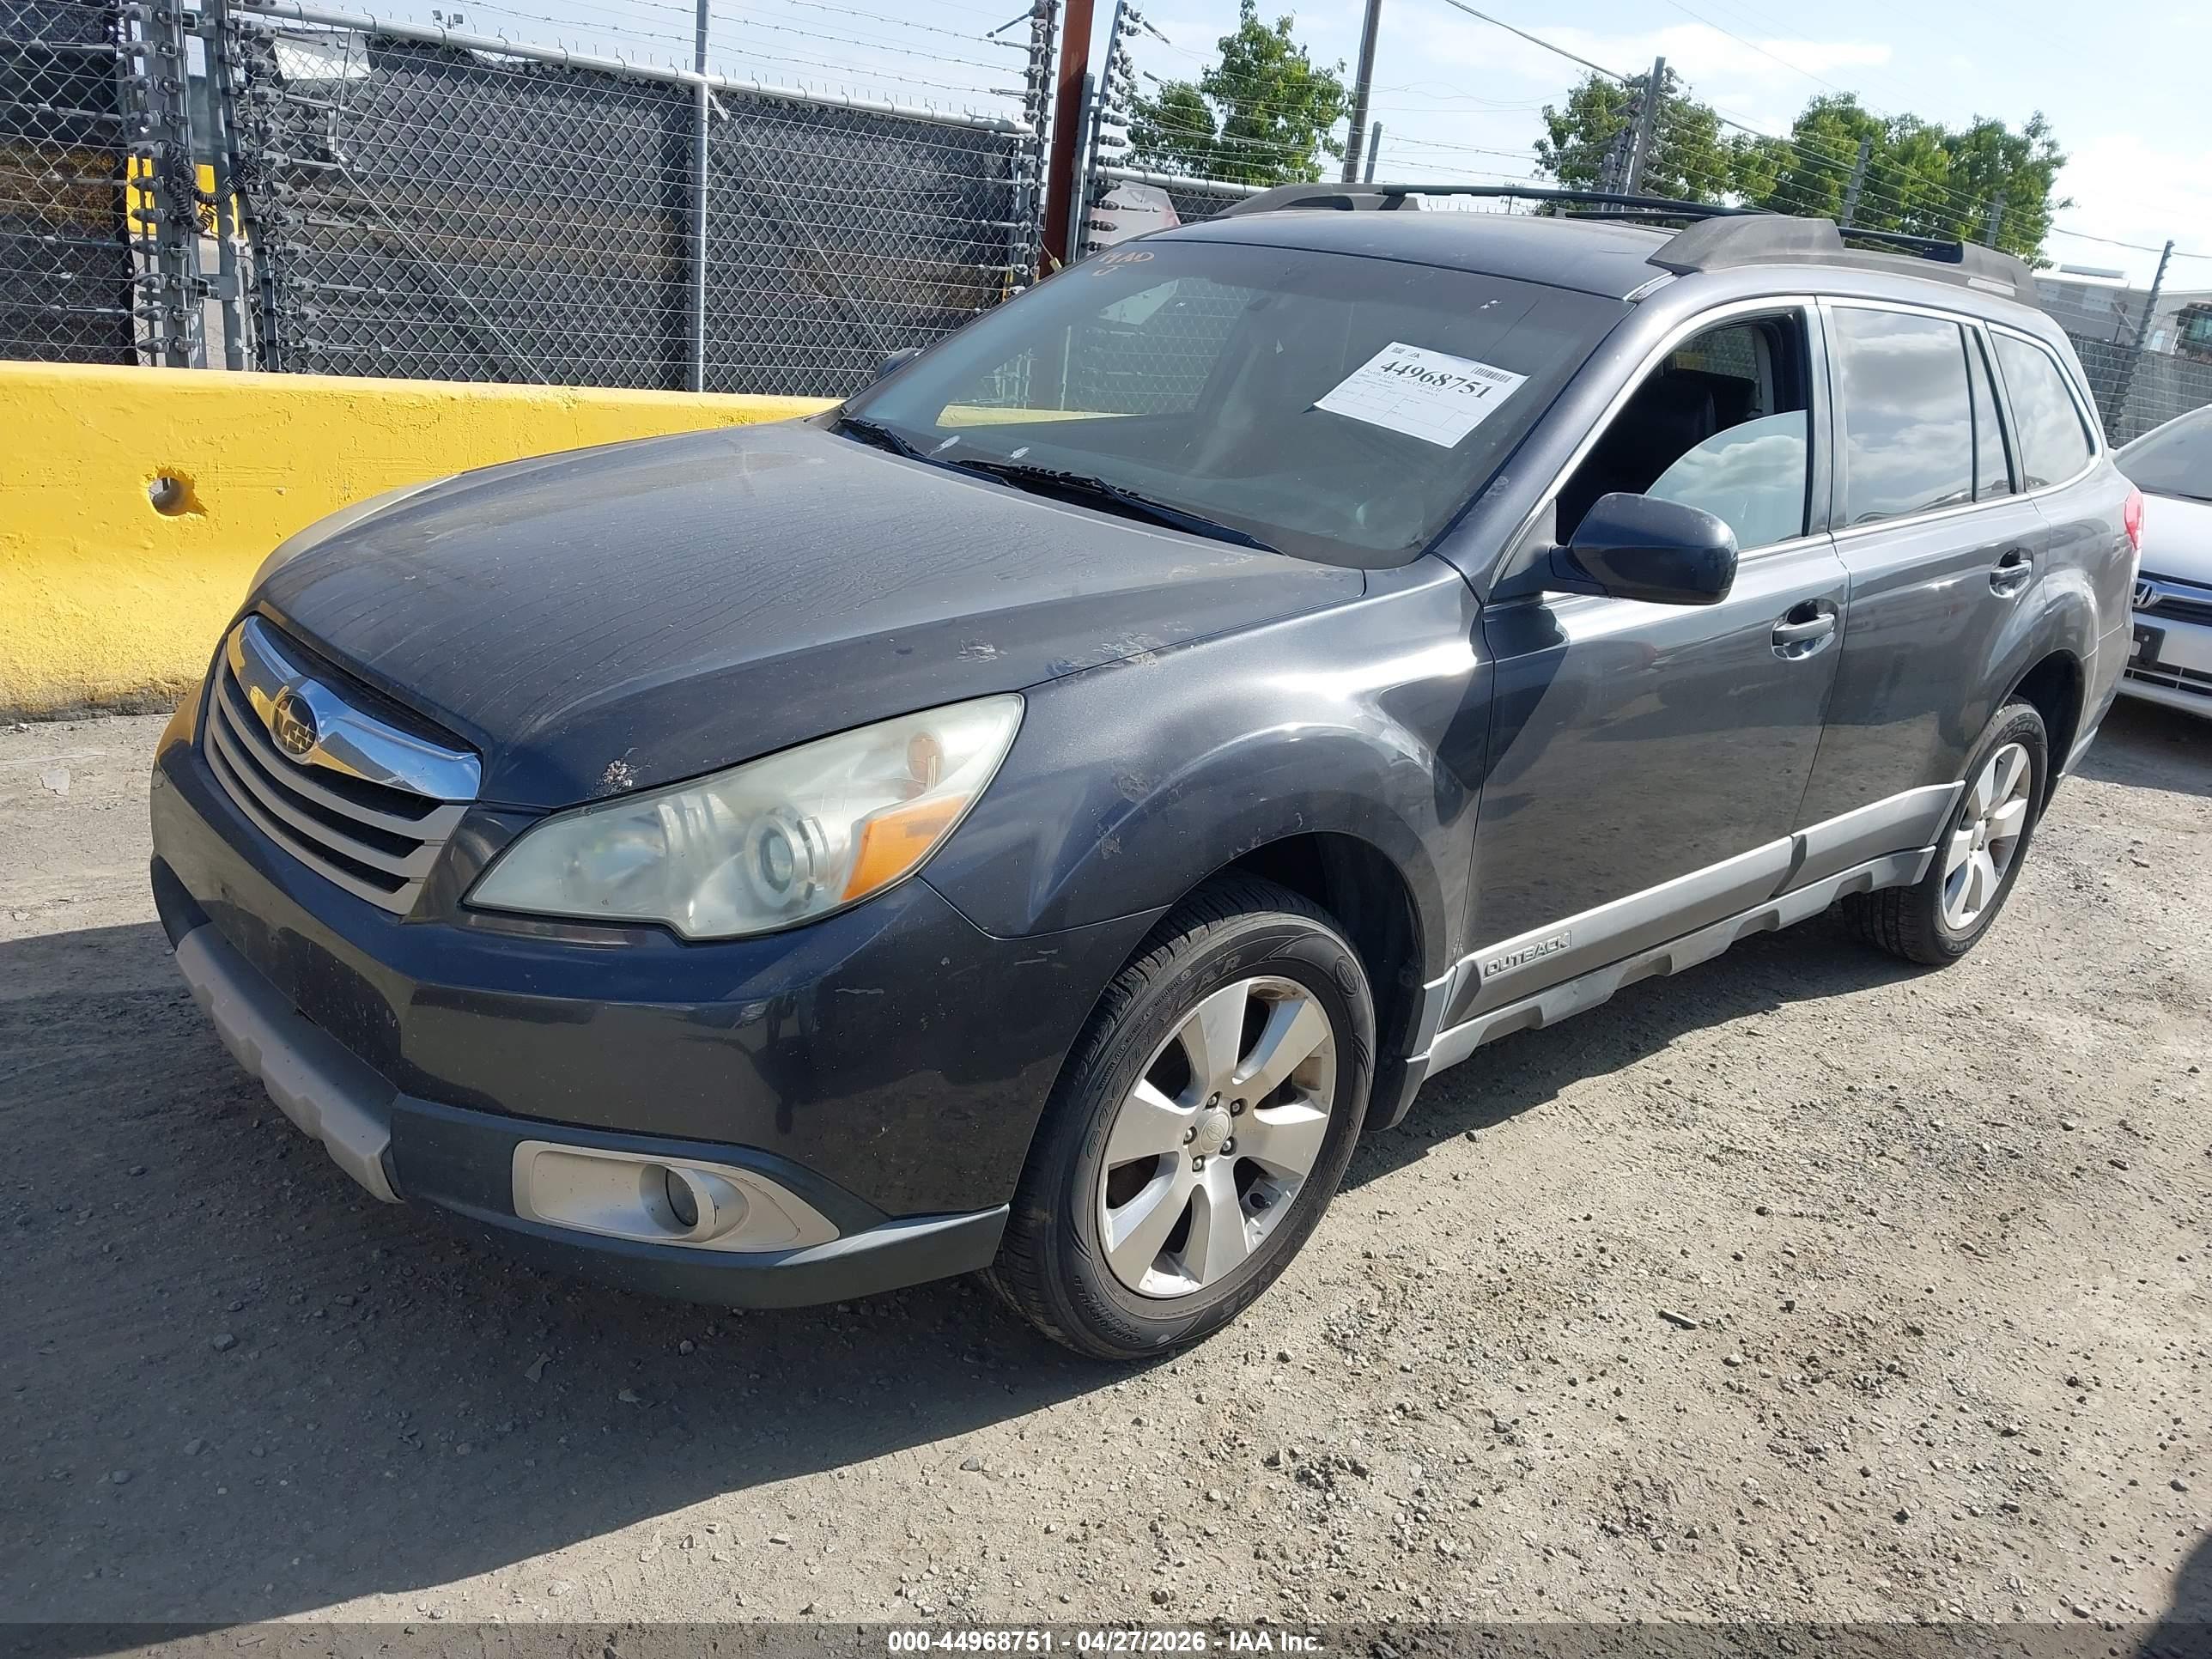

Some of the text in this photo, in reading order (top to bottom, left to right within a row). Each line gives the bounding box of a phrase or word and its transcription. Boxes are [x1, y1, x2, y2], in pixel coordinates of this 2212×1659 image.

[1380, 360, 1494, 399] 44968751
[1485, 932, 1570, 977] OUTBACK
[1087, 954, 1243, 1159] GOODYEAR
